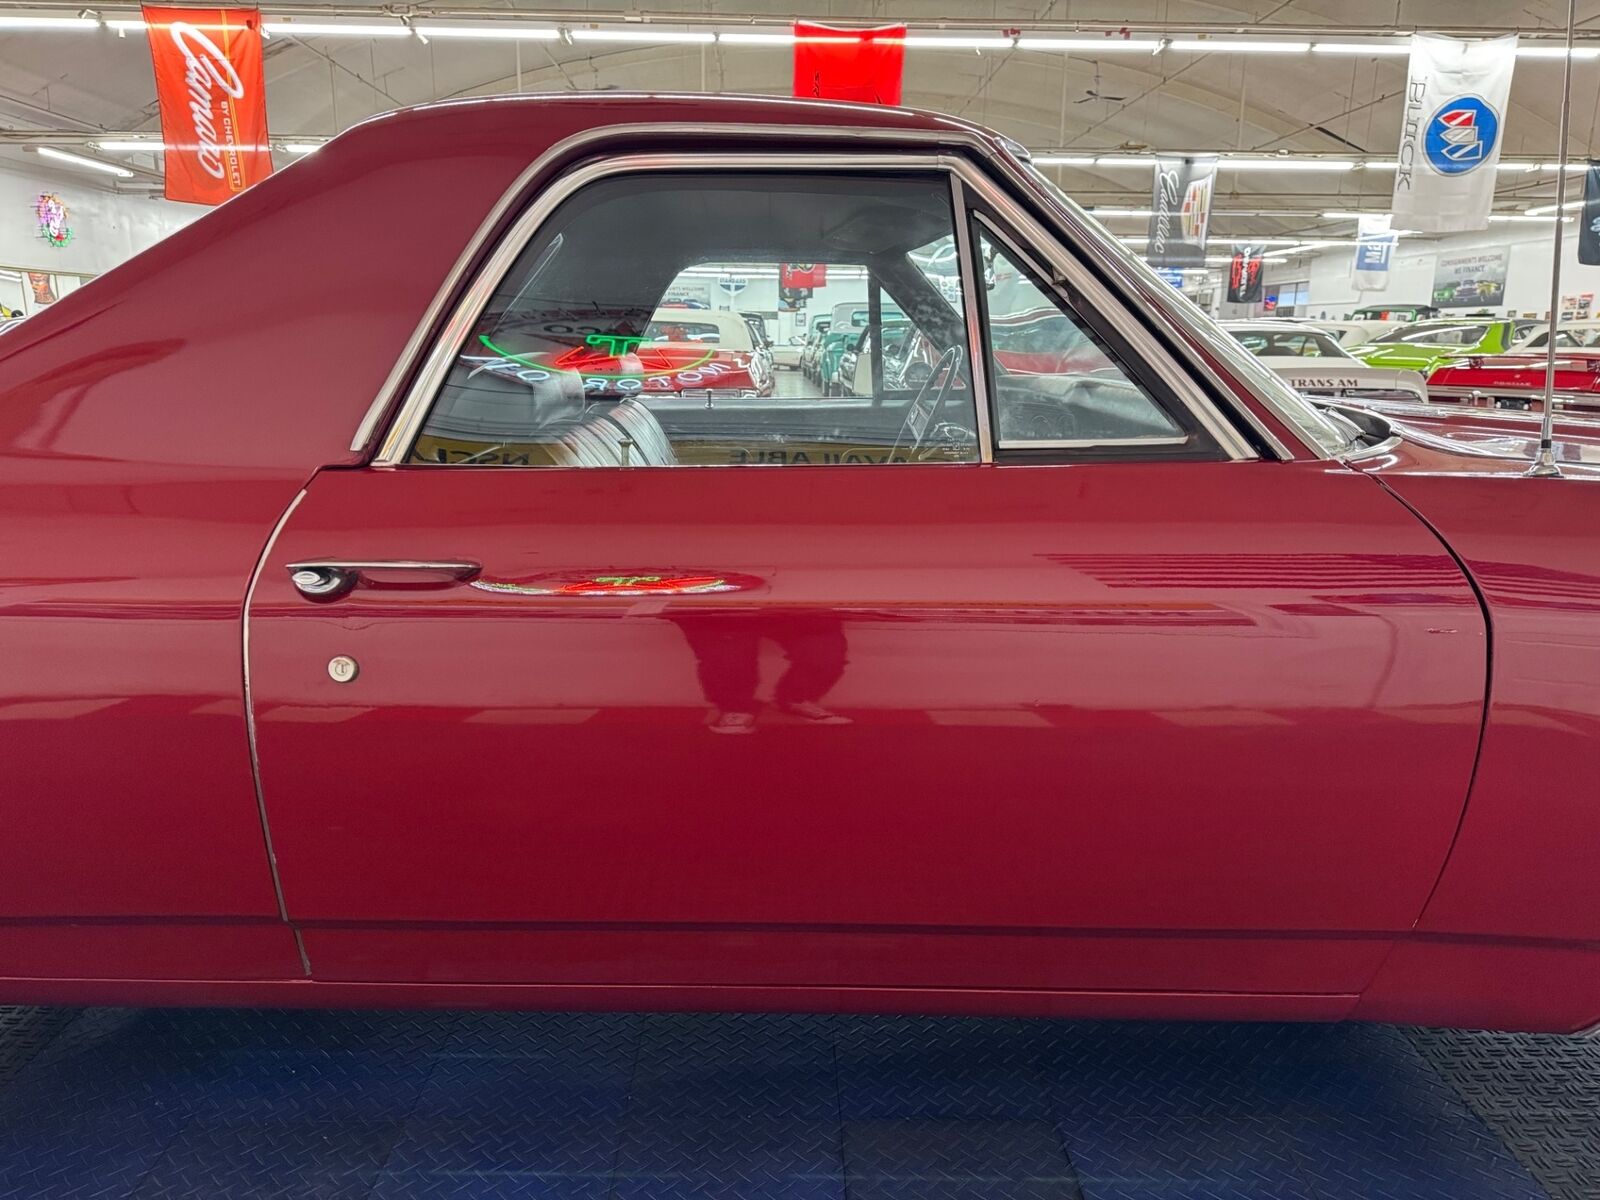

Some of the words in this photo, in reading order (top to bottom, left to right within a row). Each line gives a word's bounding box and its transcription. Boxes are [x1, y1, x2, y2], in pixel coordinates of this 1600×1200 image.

[169, 22, 244, 179] Camaro
[220, 101, 230, 112] BY
[1397, 77, 1427, 190] BUICK
[223, 119, 241, 185] CHEVROLET
[1155, 170, 1179, 254] Cadillac
[1288, 379, 1334, 387] TRANS
[1337, 379, 1358, 387] AM
